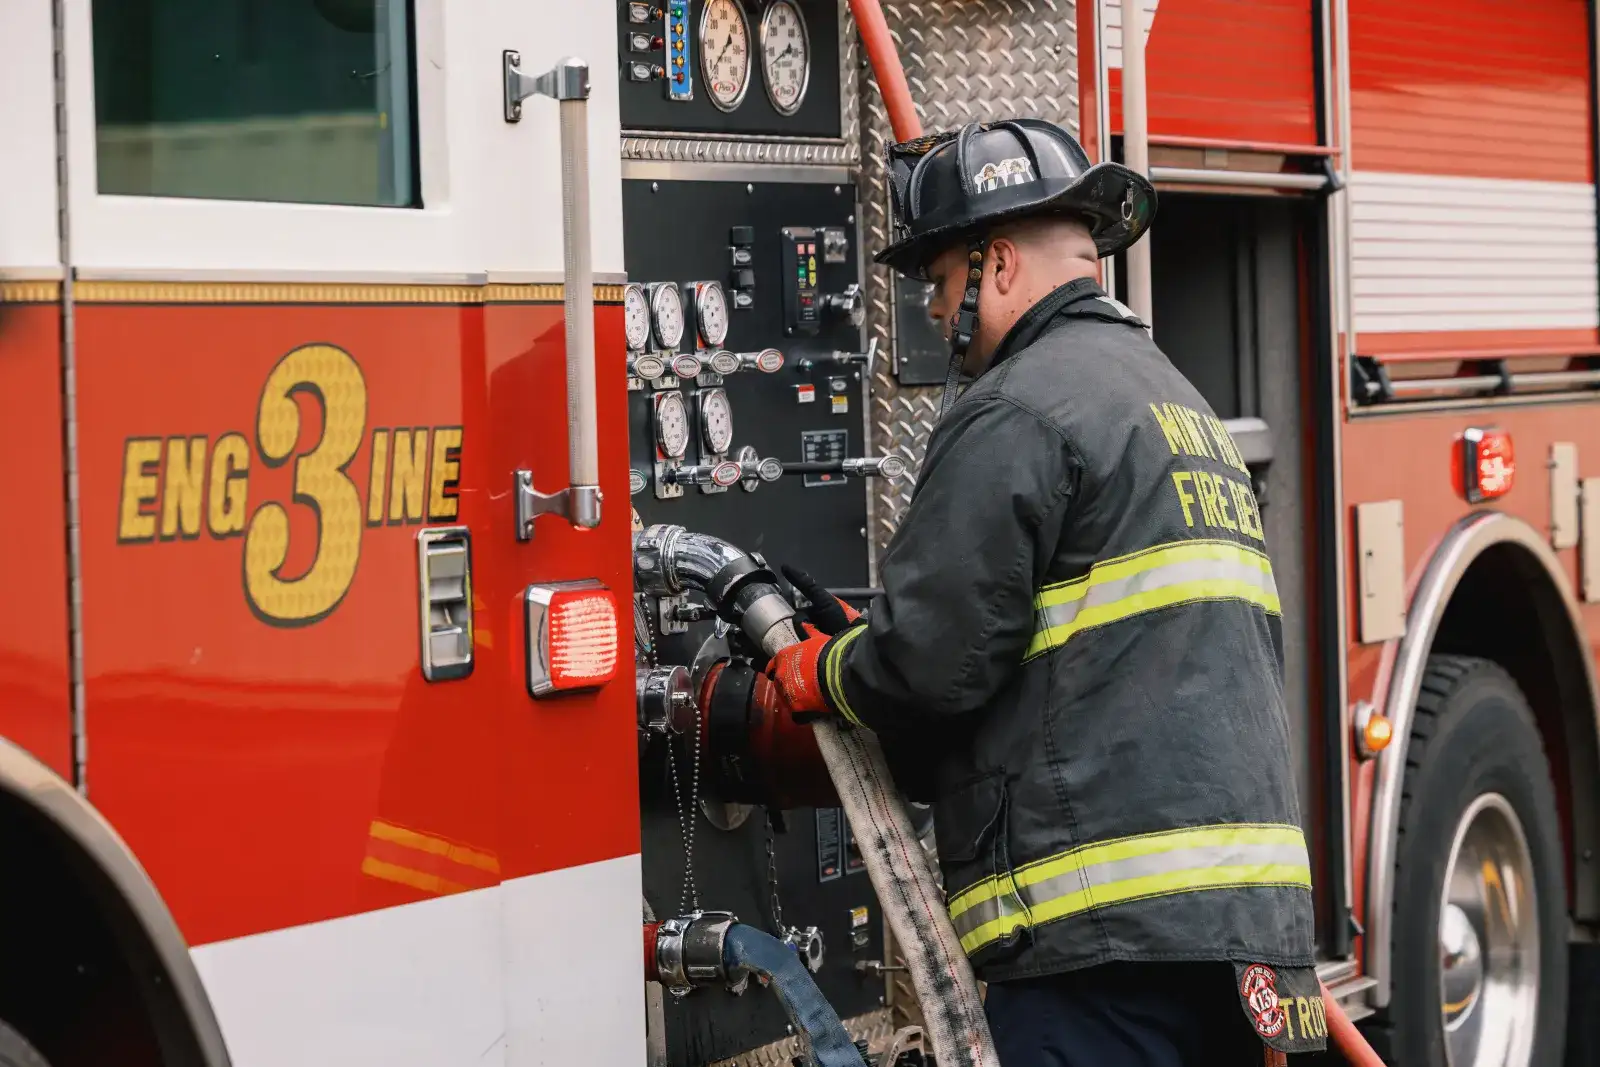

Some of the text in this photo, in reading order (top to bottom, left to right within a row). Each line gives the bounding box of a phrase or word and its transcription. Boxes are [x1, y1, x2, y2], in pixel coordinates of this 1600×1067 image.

[1148, 402, 1218, 461] MINT
[242, 341, 368, 629] 3
[1171, 471, 1238, 531] FIRE
